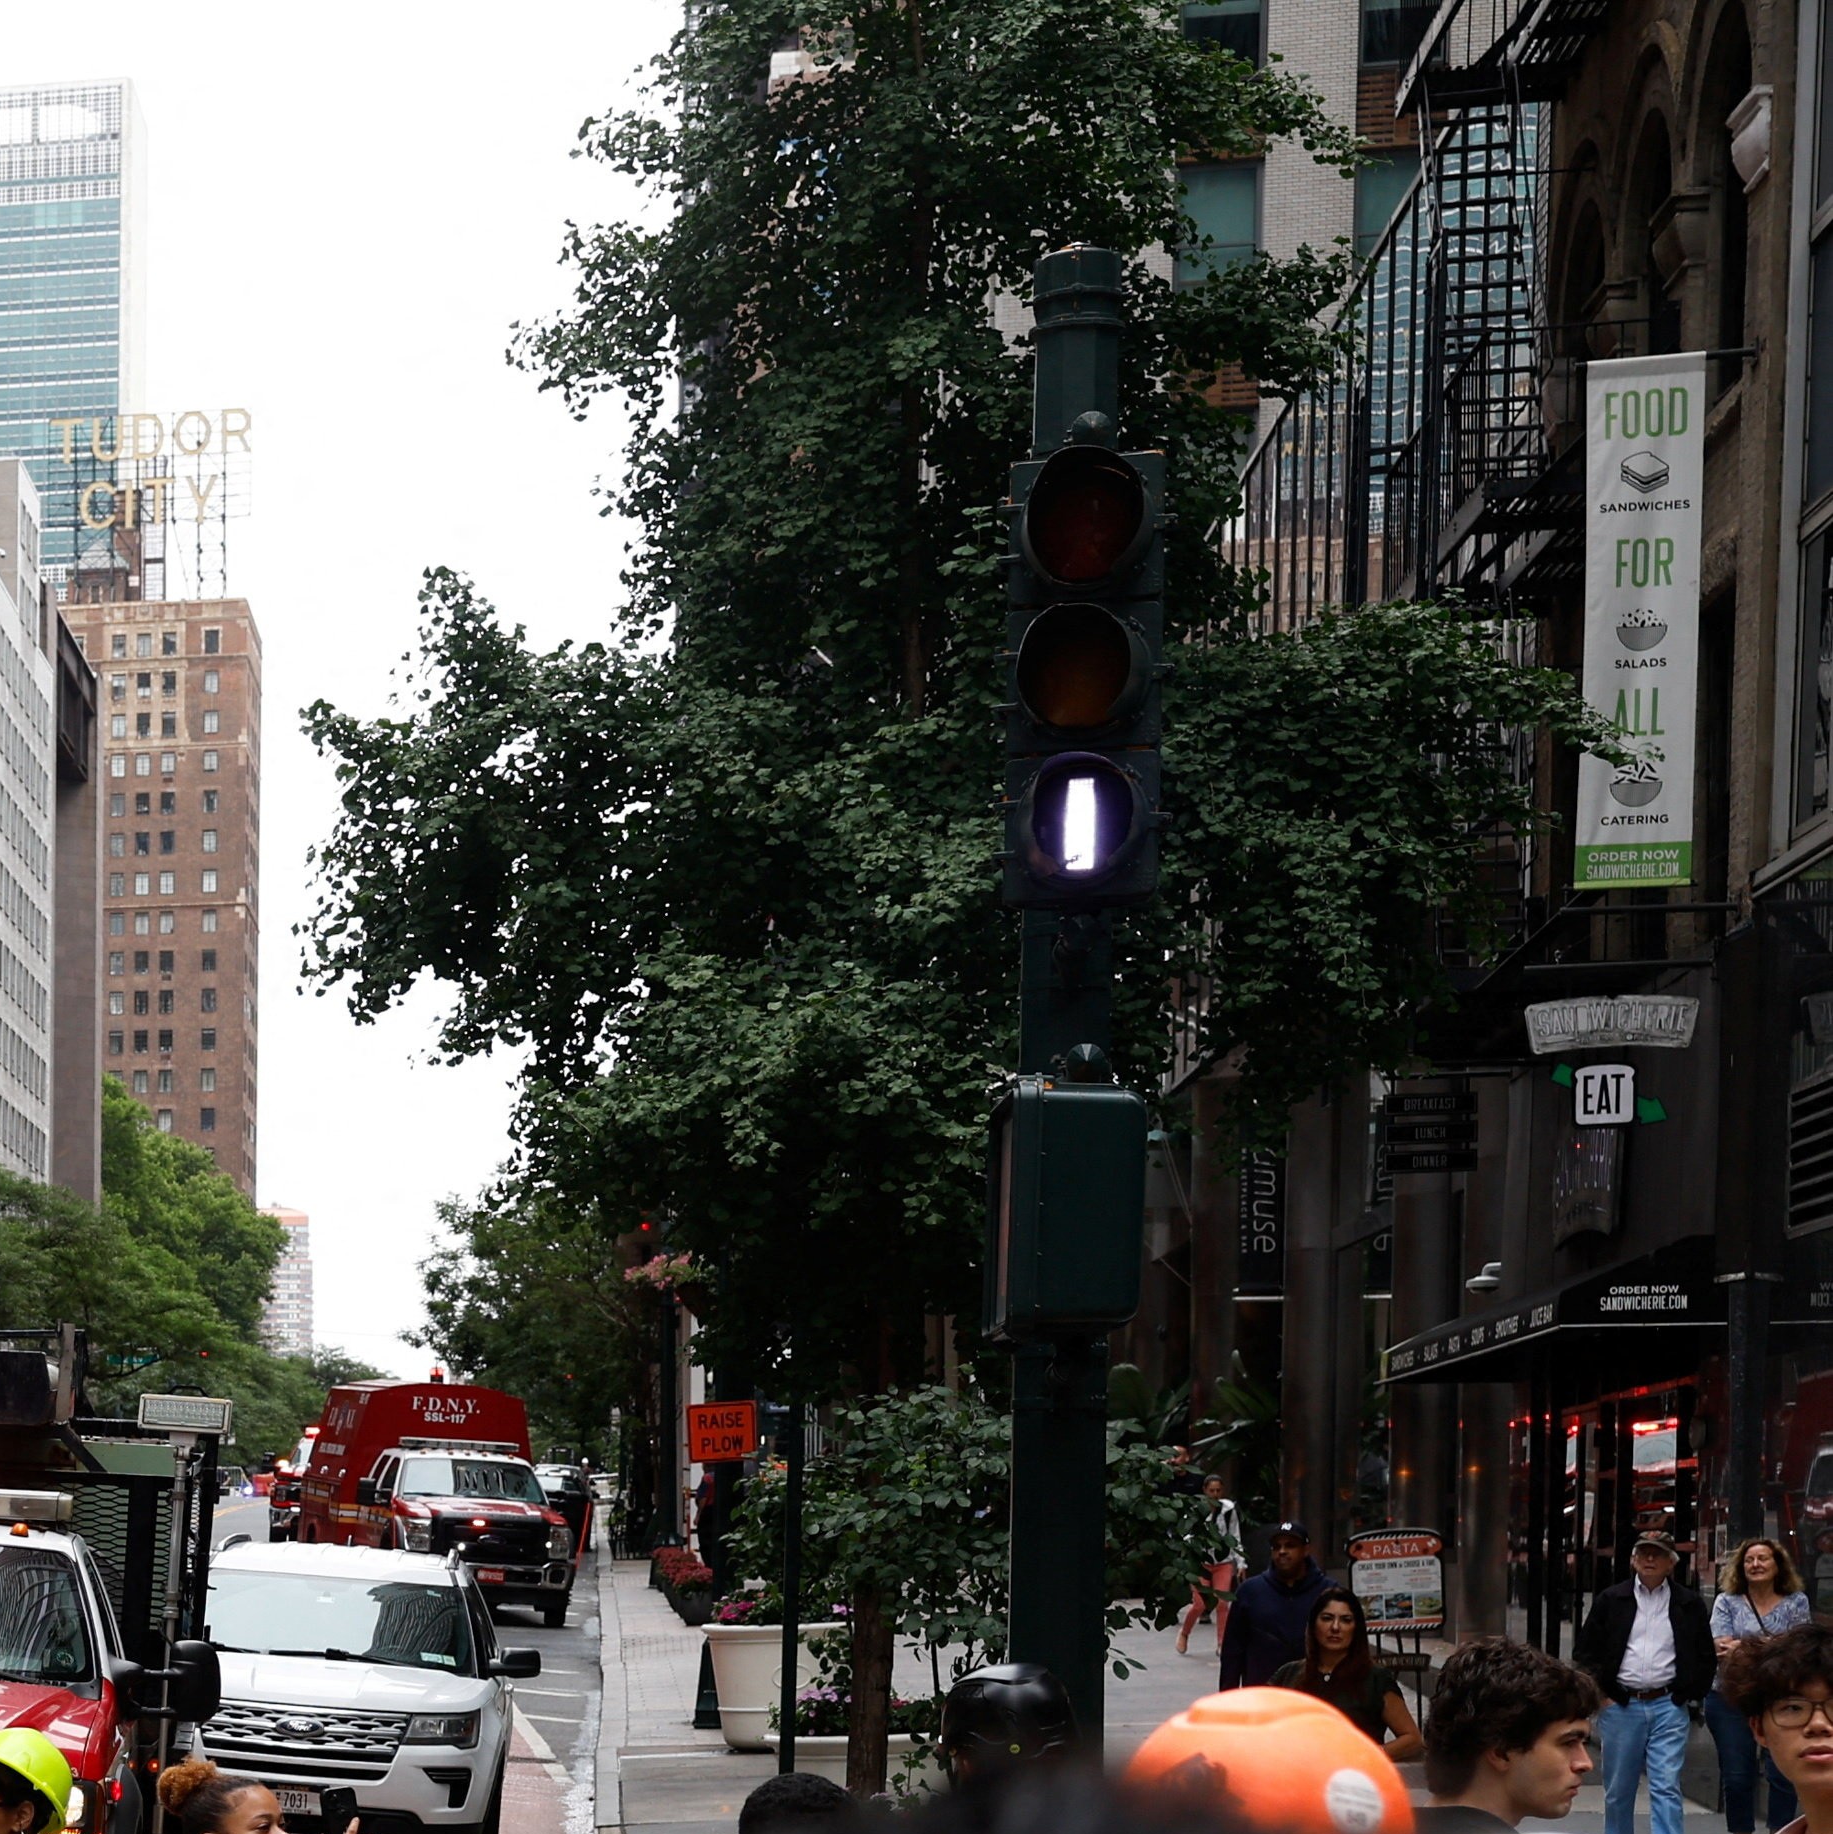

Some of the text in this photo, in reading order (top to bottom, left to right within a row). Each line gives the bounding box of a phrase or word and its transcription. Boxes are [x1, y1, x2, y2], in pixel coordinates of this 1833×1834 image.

[1604, 387, 1688, 440] FOOD
[50, 408, 252, 464] TUDOR
[80, 474, 218, 530] CITY
[1600, 499, 1691, 513] SANDWICHES
[1615, 537, 1674, 588] FOR
[1614, 657, 1667, 669] SALADS
[1614, 687, 1665, 737] ALL
[1601, 814, 1669, 825] CATERING
[1588, 849, 1680, 862] ORDER NOW
[1586, 861, 1680, 880] SANDWICHERIE.COM
[1536, 1002, 1688, 1036] SANDWICHERIE
[1583, 1073, 1625, 1115] EAT
[1404, 1096, 1456, 1111] BREAKFAST
[1415, 1126, 1446, 1140] LUNCH
[1413, 1154, 1448, 1168] DINNER
[1609, 1284, 1680, 1295] ORDER NOW
[1600, 1295, 1688, 1312] SANDWICHERIE.COM
[412, 1396, 481, 1415] F.D.N.Y.
[424, 1412, 466, 1424] SSL-117
[697, 1411, 744, 1430] RAISE
[701, 1434, 744, 1454] PLOW
[284, 1792, 308, 1809] 7031
